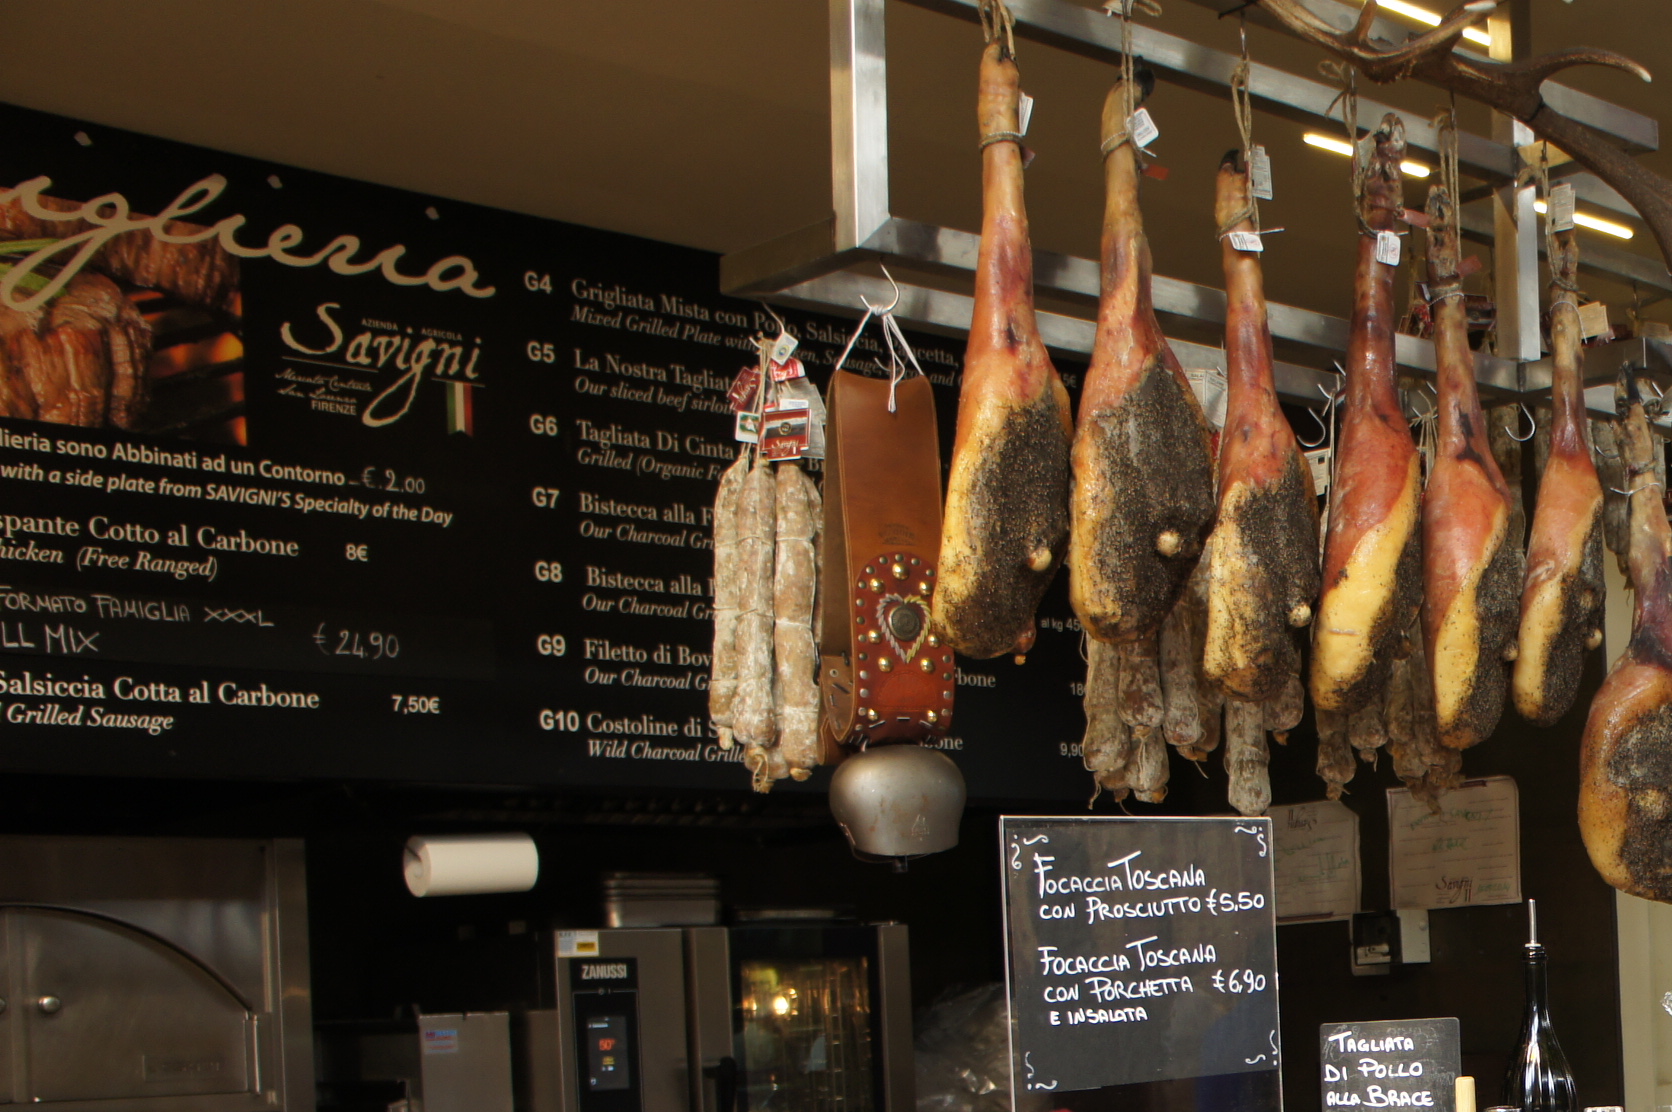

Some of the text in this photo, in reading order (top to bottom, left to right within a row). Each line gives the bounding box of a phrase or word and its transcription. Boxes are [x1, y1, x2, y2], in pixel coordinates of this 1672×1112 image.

[524, 271, 747, 328] G4 Grigliata Mista con
[571, 305, 721, 345] Mixed Grilled Plate
[280, 302, 483, 427] Savigni
[527, 341, 667, 382] G5 La Nostra
[311, 400, 357, 416] FIRENZE
[575, 376, 690, 412] Our sliced beef
[530, 414, 734, 460] G6 Tagliata Di Cinta
[56, 439, 107, 460] sono
[112, 441, 198, 473] Abbinati
[202, 454, 225, 474] ad
[231, 460, 255, 477] un
[259, 460, 345, 486] Contorno
[577, 448, 703, 480] Grilled (Organic
[0, 465, 43, 485] with
[49, 471, 61, 485] a
[65, 469, 103, 489] side
[109, 474, 155, 498] plate
[158, 477, 201, 498] from
[295, 494, 369, 519] Specialty
[373, 502, 390, 519] of
[392, 504, 418, 521] the
[421, 508, 453, 527] Day
[532, 487, 695, 525] G7 Bistecca alla
[88, 517, 368, 563] Cotto al Carbone 8€
[580, 520, 686, 547] Our Charcoal
[77, 547, 218, 581] (Free Ranged)
[535, 561, 702, 596] G8 Bistecca alla
[94, 594, 190, 622] FAMIGLIA
[46, 623, 99, 653] MIX
[537, 635, 671, 665] G9 Filetto di
[113, 677, 440, 714] Cotta al Carbone 7,50€
[7, 705, 174, 735] Grilled Sausage
[539, 709, 701, 737] G10 Costoline di
[588, 739, 700, 761] Wild Charcoal
[1034, 850, 1206, 899] FOCACCIA TOSCANA
[1039, 903, 1075, 919] CON
[1086, 896, 1201, 924] PROSCIUTTO
[581, 963, 627, 980] ZANUSSI
[1038, 936, 1216, 975] FOCACCIA TOSCANA
[1044, 984, 1079, 1003] CON
[1085, 976, 1193, 1003] PORCHETTA
[1050, 1007, 1148, 1026] E INSALATA
[1328, 1030, 1414, 1052] TAGLIATA
[1324, 1058, 1423, 1082] DI POLLO
[1326, 1085, 1434, 1108] ALLA BRACE
